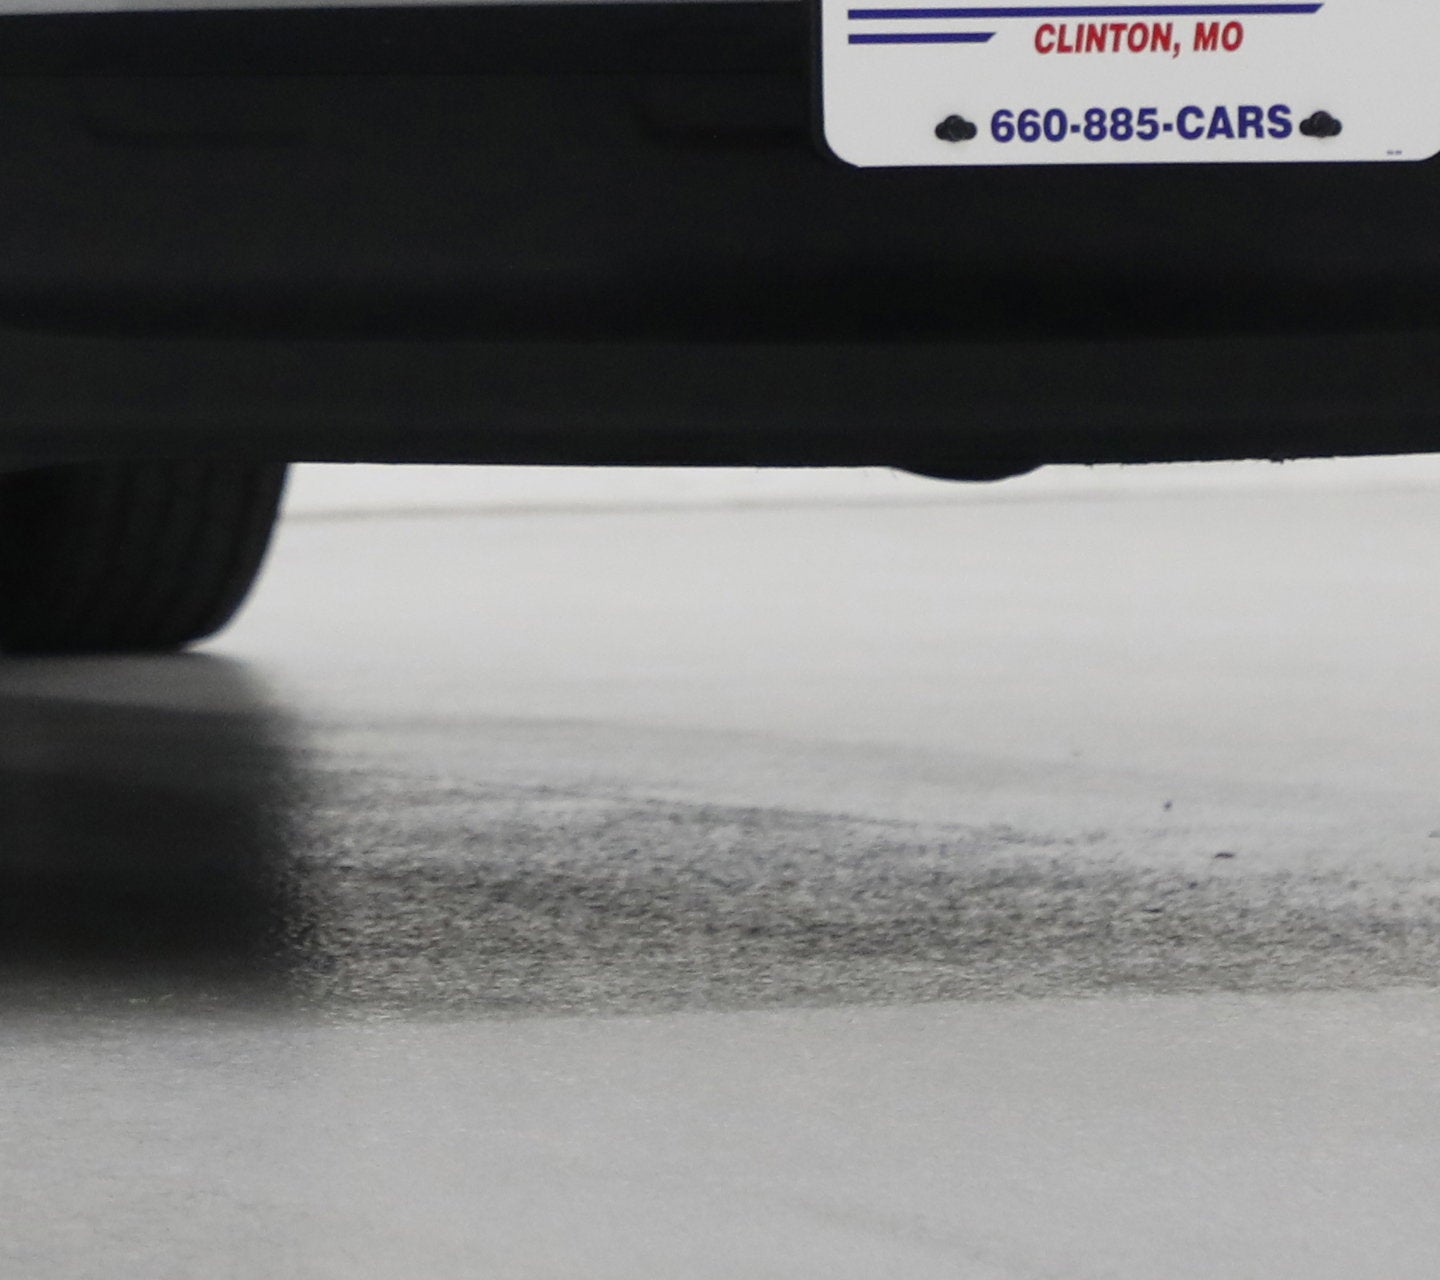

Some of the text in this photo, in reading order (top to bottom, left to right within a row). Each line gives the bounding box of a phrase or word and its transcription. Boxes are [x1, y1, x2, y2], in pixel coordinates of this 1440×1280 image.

[1035, 21, 1243, 59] CLINTON, MO
[990, 104, 1292, 142] 660-885-CARS
